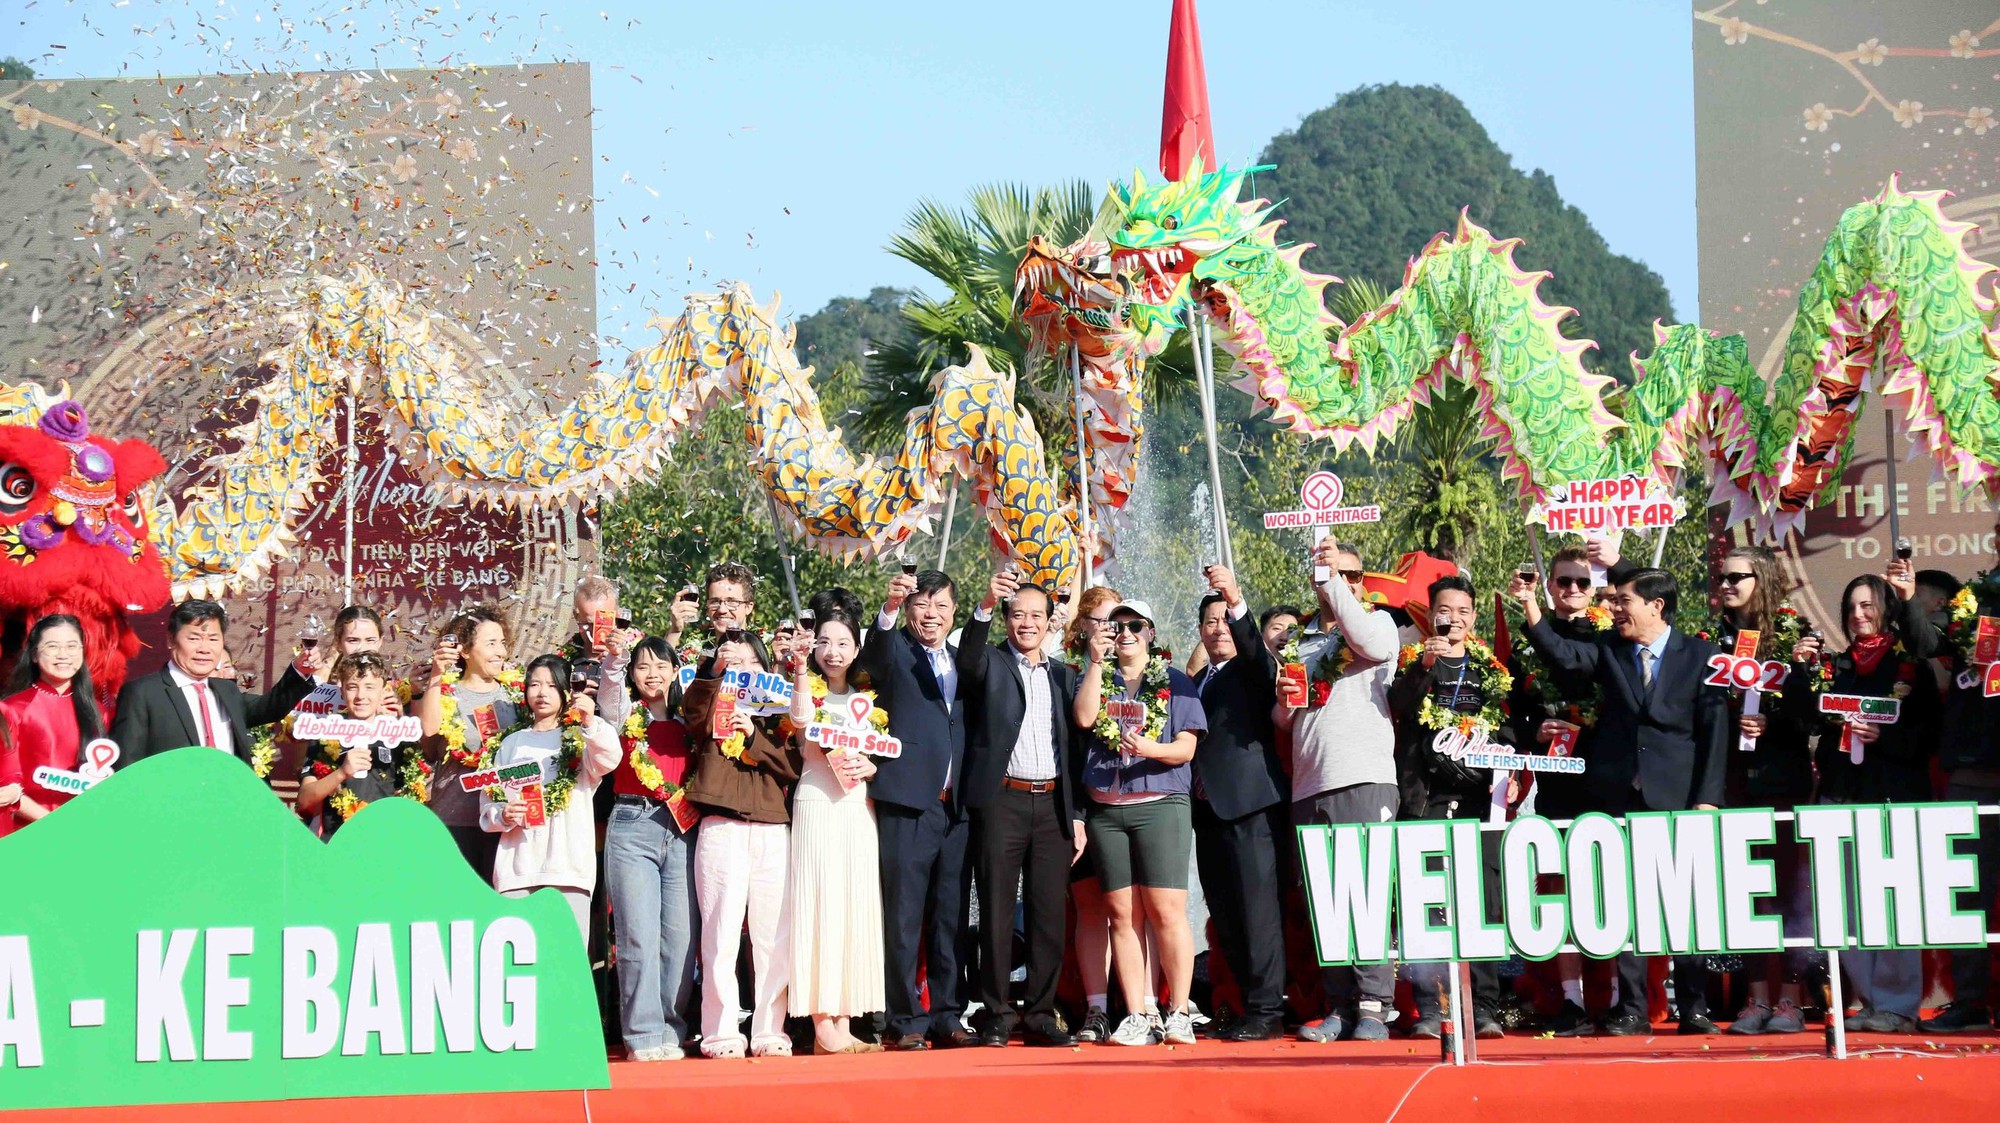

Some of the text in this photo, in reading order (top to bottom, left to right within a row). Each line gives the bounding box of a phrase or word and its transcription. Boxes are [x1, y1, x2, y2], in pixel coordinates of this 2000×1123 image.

[1569, 478, 1649, 504] HAPPY
[1837, 481, 2000, 518] THE FIR
[1265, 507, 1377, 527] WORLD HERITAGE
[1547, 503, 1675, 531] NEW YEAR
[1841, 536, 1881, 560] TO
[314, 684, 337, 703] ông
[1822, 695, 1861, 712] DARK
[298, 715, 367, 744] Heritage
[372, 719, 418, 744] Night
[864, 734, 898, 755] Sơn
[1435, 727, 1512, 759] Welcome
[498, 761, 541, 781] SPRING
[1467, 753, 1585, 772] THE FIRST VISITORS
[1297, 802, 1988, 966] WELCOME THE
[135, 927, 256, 1063] KE
[280, 916, 538, 1060] BANG
